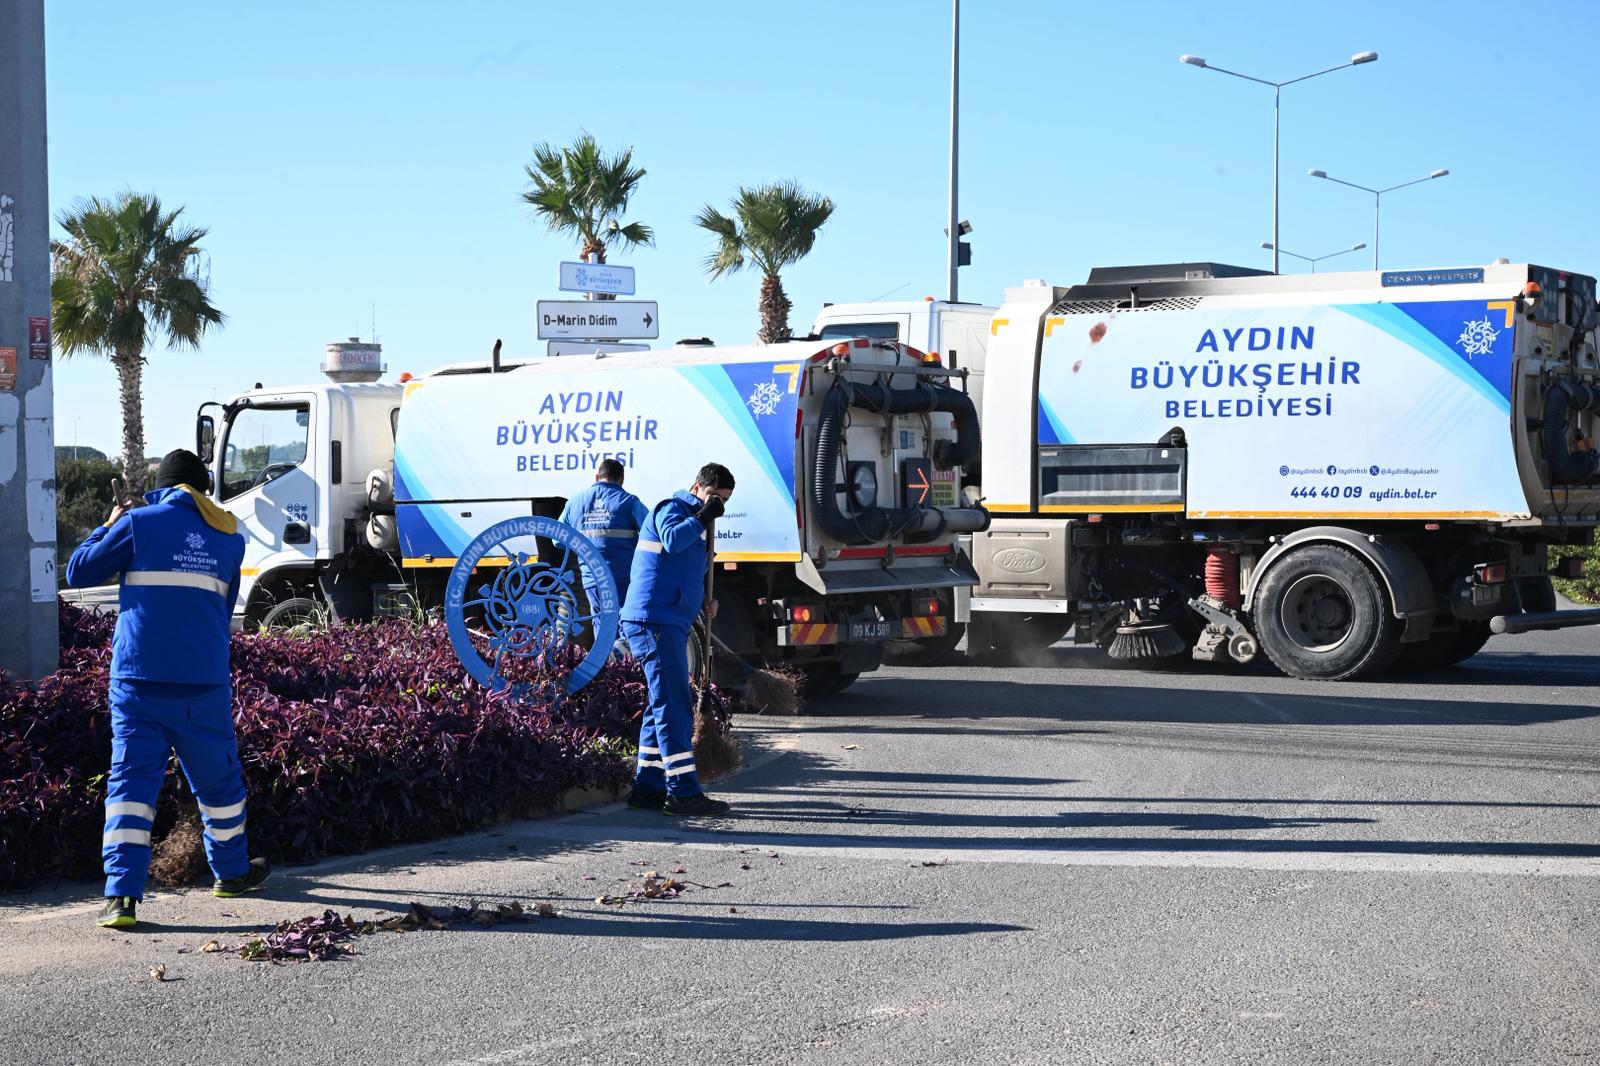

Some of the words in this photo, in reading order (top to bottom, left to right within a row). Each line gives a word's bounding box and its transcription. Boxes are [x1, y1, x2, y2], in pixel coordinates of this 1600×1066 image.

[1427, 271, 1479, 281] SWEEPERS
[543, 314, 586, 326] D-Marin
[588, 314, 618, 326] Didim
[1195, 325, 1315, 353] AYDIN
[1130, 356, 1361, 394] BÜYÜKŞEHİR
[538, 390, 623, 415] AYDIN
[1165, 392, 1332, 419] BELEDİYESİ
[496, 415, 658, 449] BÜYÜKŞEHİR
[1290, 486, 1317, 499] 444
[1320, 486, 1340, 499] 40
[1343, 486, 1363, 499] 09
[1369, 488, 1438, 502] aydin.bel.tr
[456, 541, 485, 582] AYDIN
[482, 519, 570, 547] BÜYÜKŞEHİR
[1002, 552, 1037, 568] Ford
[864, 623, 875, 637] KJ
